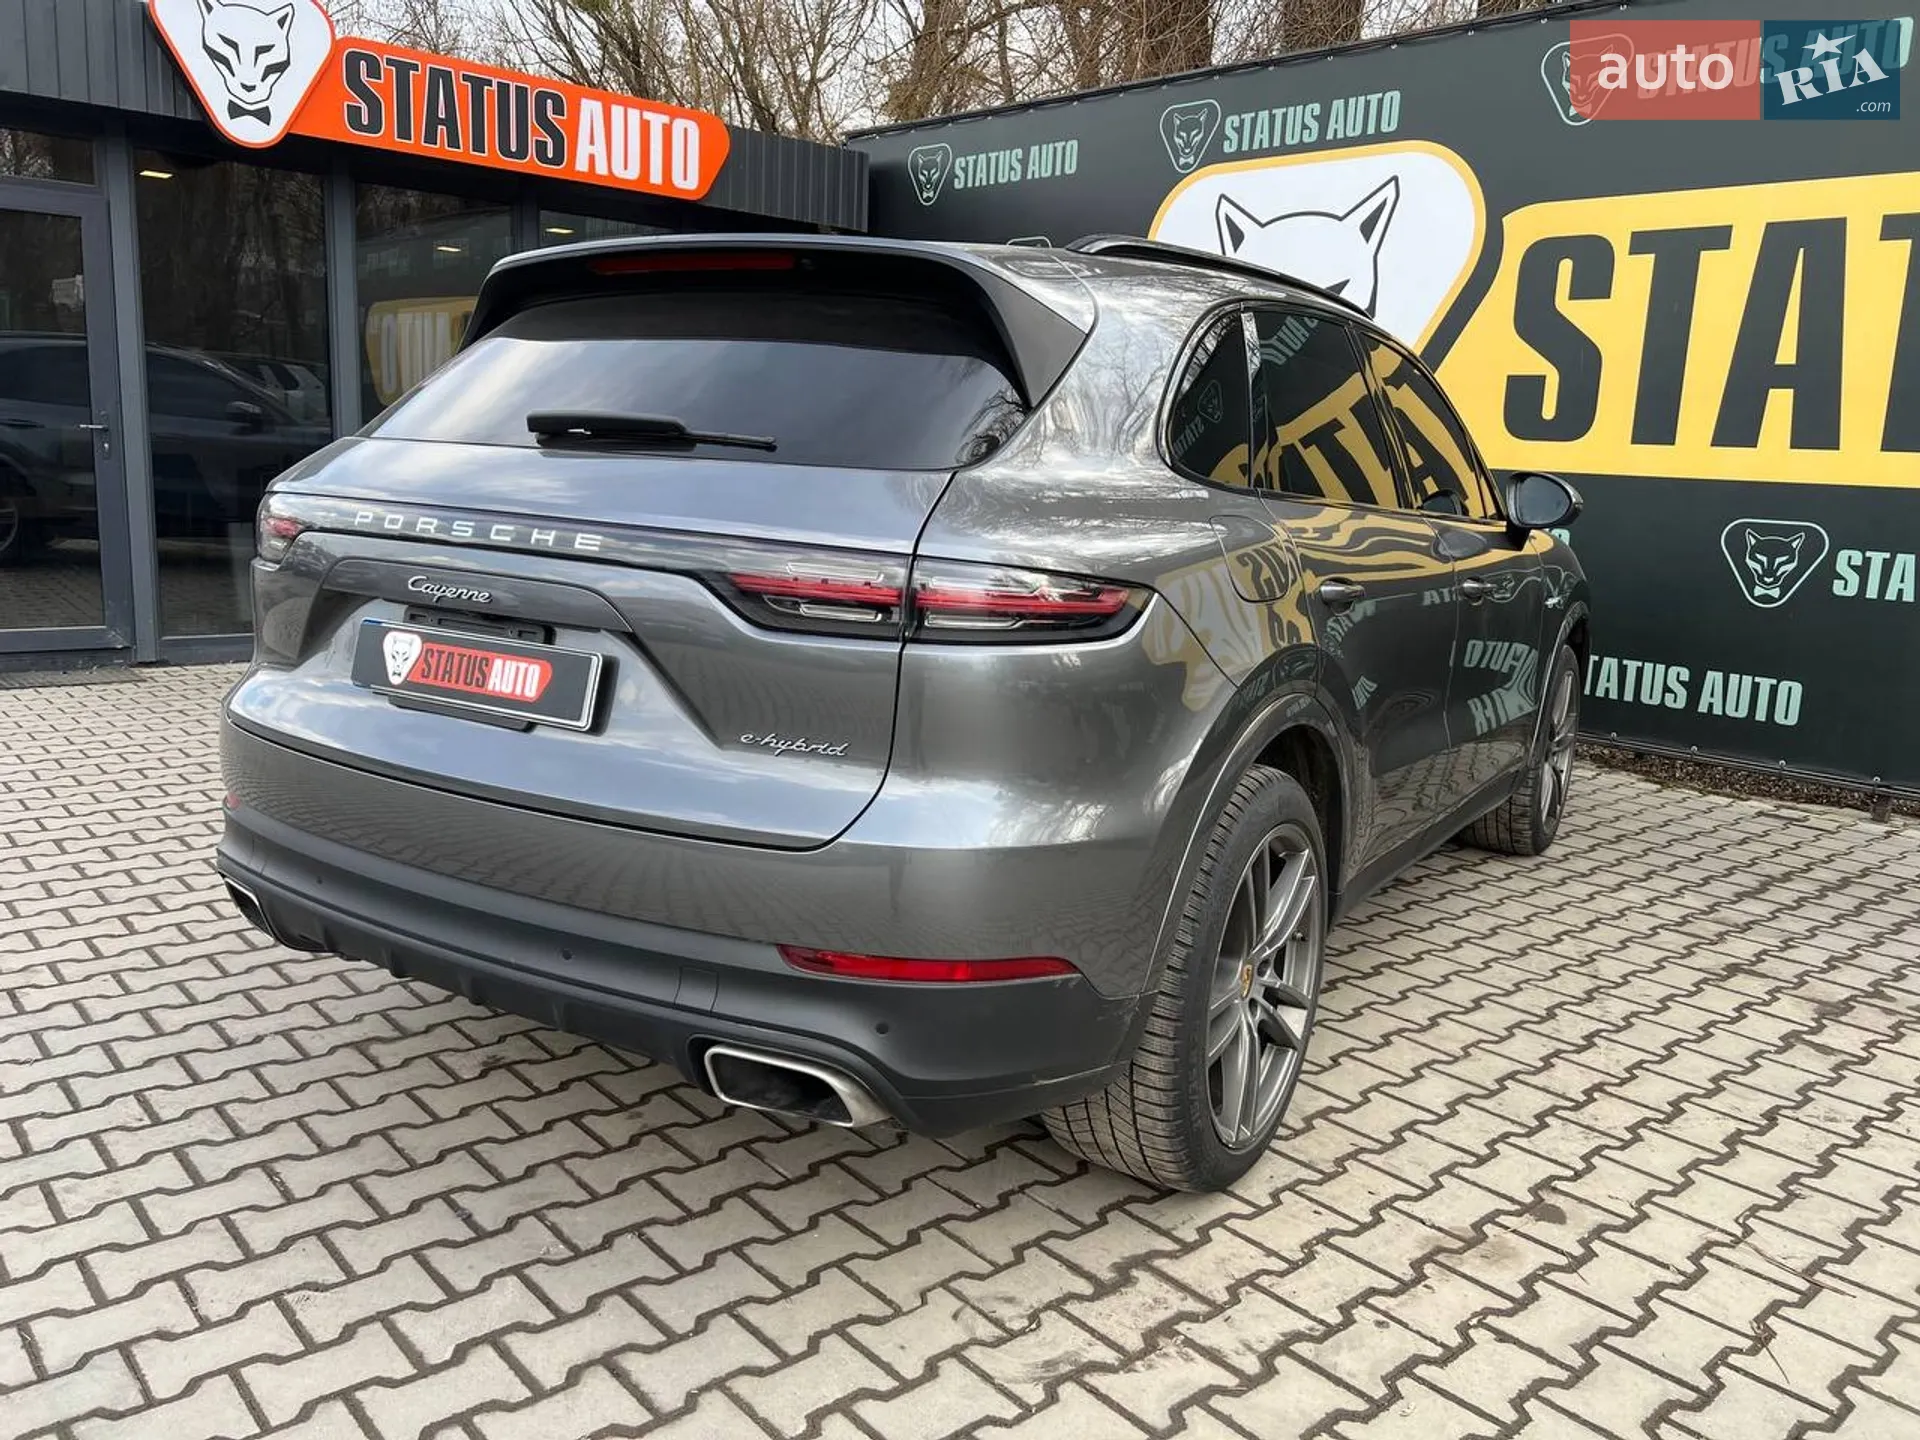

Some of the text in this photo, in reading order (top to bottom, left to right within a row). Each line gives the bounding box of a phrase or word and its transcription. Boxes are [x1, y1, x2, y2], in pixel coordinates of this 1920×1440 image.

[342, 48, 700, 191] STATUS AUTO
[1223, 90, 1401, 154] STATUS AUTO
[953, 139, 1079, 190] STATUS AUTO
[354, 512, 605, 551] PORSCHE
[408, 575, 492, 604] Cayenne
[421, 647, 542, 698] STATUS AUTO
[1697, 669, 1804, 727] AUTO
[740, 733, 849, 757] e-hybrid
